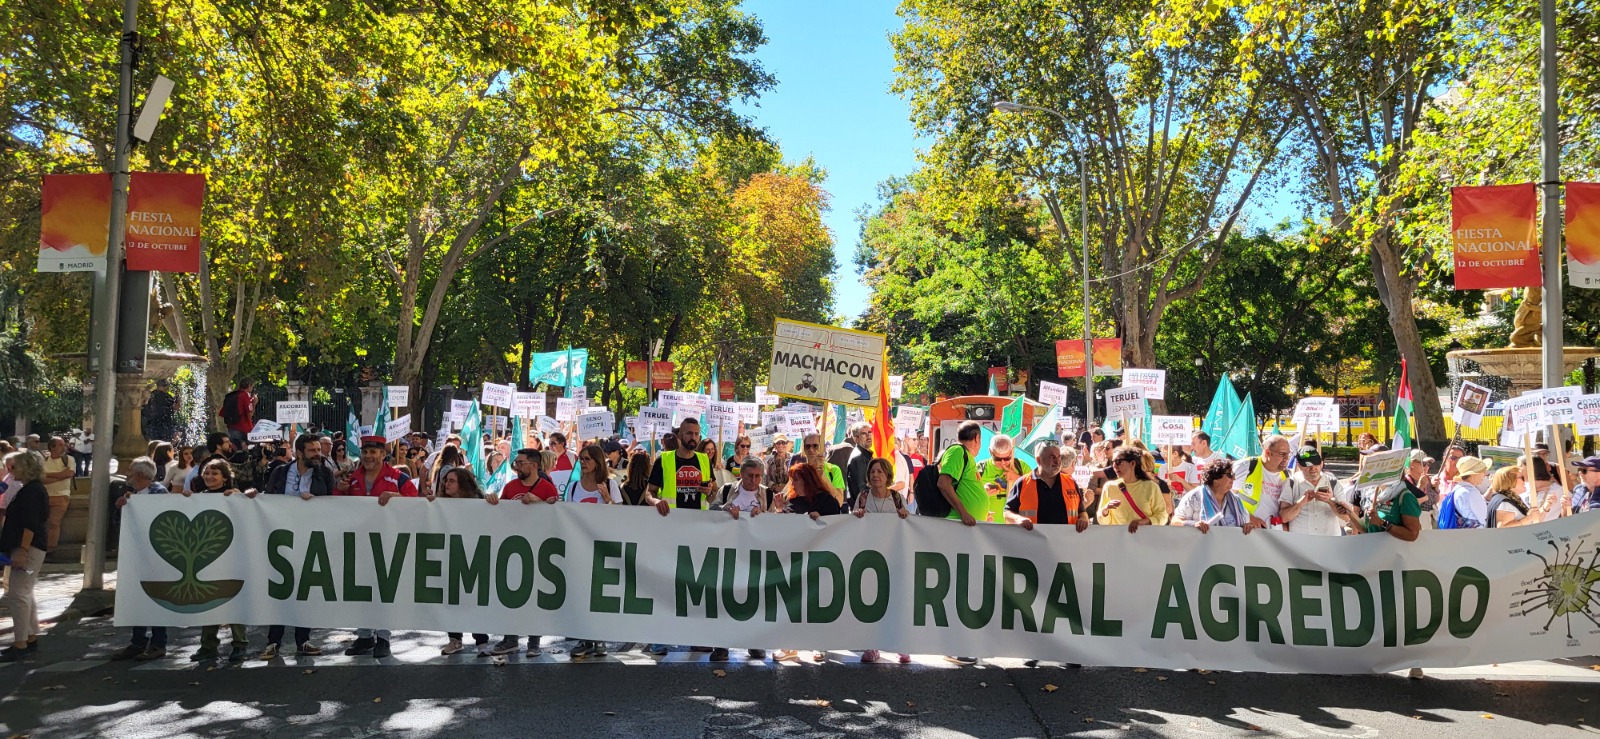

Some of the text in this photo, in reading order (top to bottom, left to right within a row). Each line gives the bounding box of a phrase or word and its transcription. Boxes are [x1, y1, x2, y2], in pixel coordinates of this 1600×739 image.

[130, 211, 173, 223] FIESTA
[128, 223, 197, 237] NACIONAL
[1456, 228, 1503, 239] FIESTA
[137, 242, 149, 250] DE
[154, 242, 187, 251] OCTUBRE
[1457, 240, 1534, 253] NACIONAL
[1468, 260, 1481, 268] DE
[1482, 258, 1525, 267] OCTUBRE
[773, 350, 875, 381] MACHACON
[1110, 392, 1140, 403] TERUEL
[710, 404, 735, 414] TERUEL
[1513, 397, 1542, 412] Caminreal
[644, 411, 670, 420] TERUEL
[1162, 421, 1184, 430] Cosa
[678, 470, 700, 478] STOP
[267, 528, 1491, 648] SALVEMOS EL MUNDO RURAL AGREDIDO
